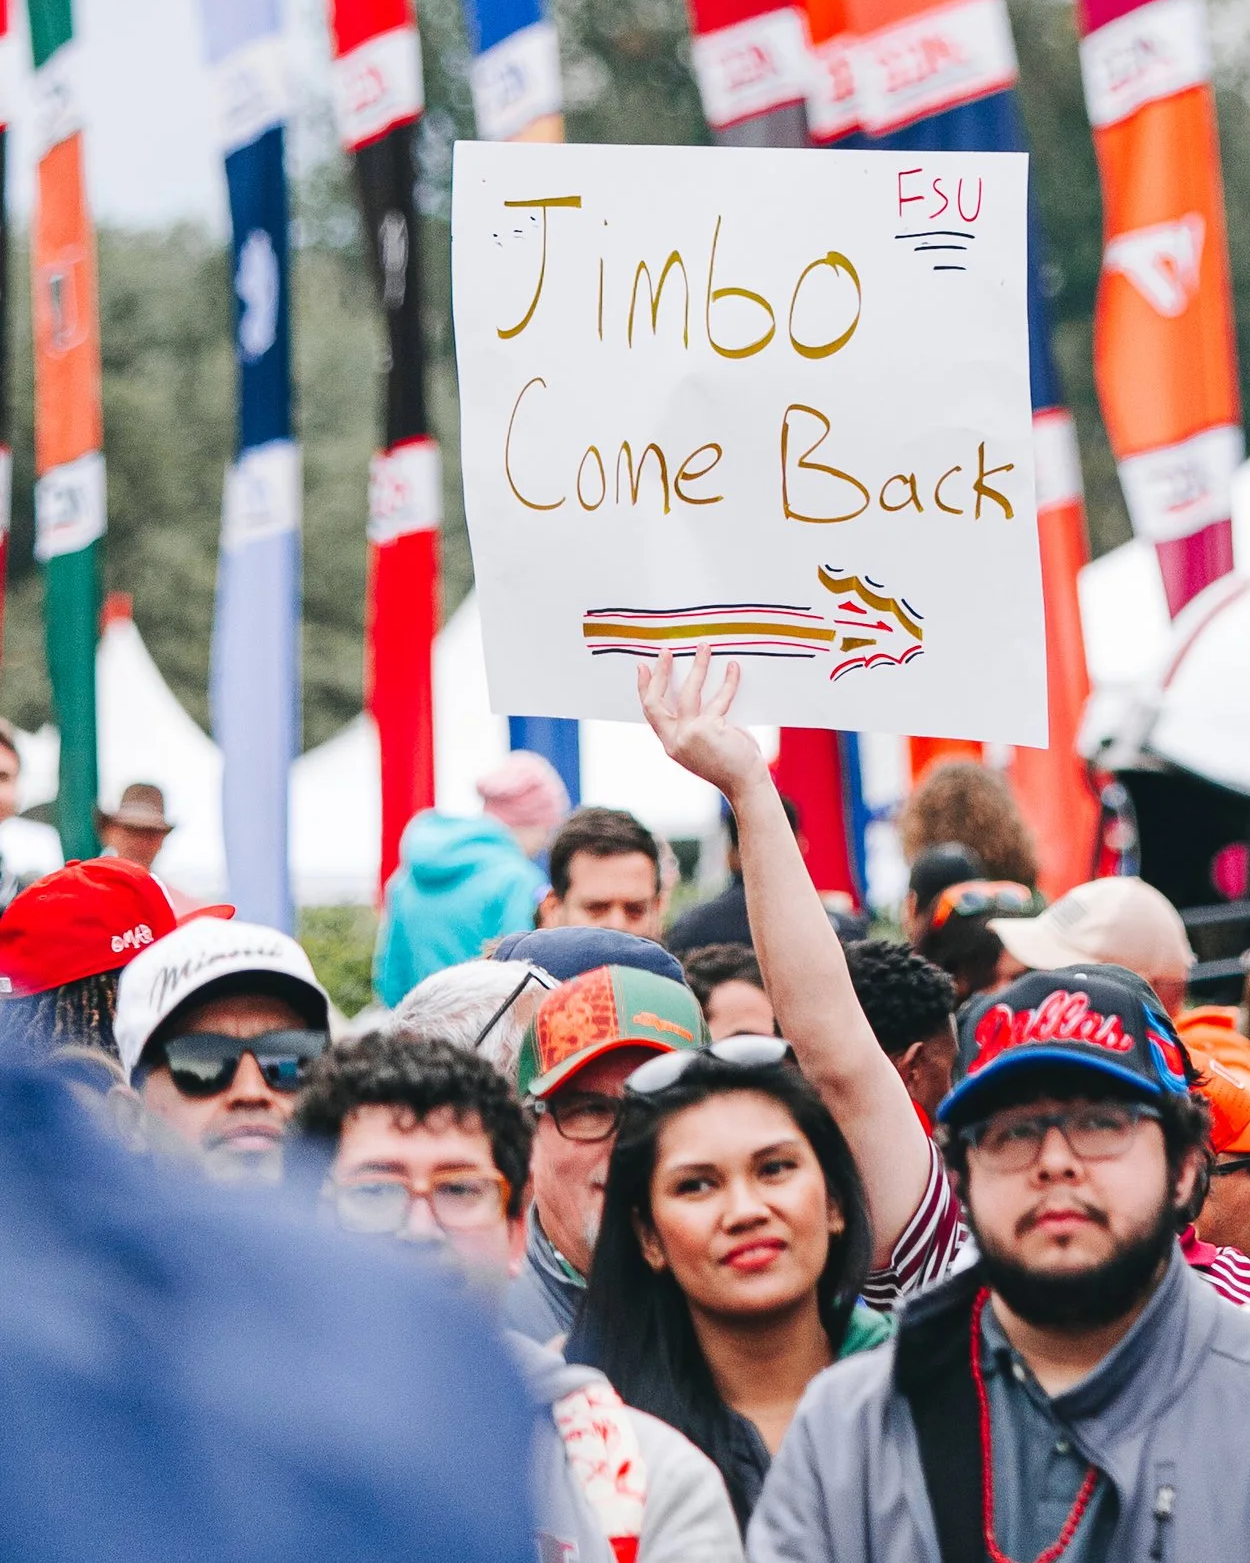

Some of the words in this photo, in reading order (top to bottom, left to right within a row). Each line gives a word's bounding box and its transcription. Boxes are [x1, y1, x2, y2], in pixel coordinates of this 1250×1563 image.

[897, 167, 983, 223] FSU
[495, 195, 862, 361] Jimbo
[504, 376, 725, 515] Come
[780, 403, 1016, 524] Back
